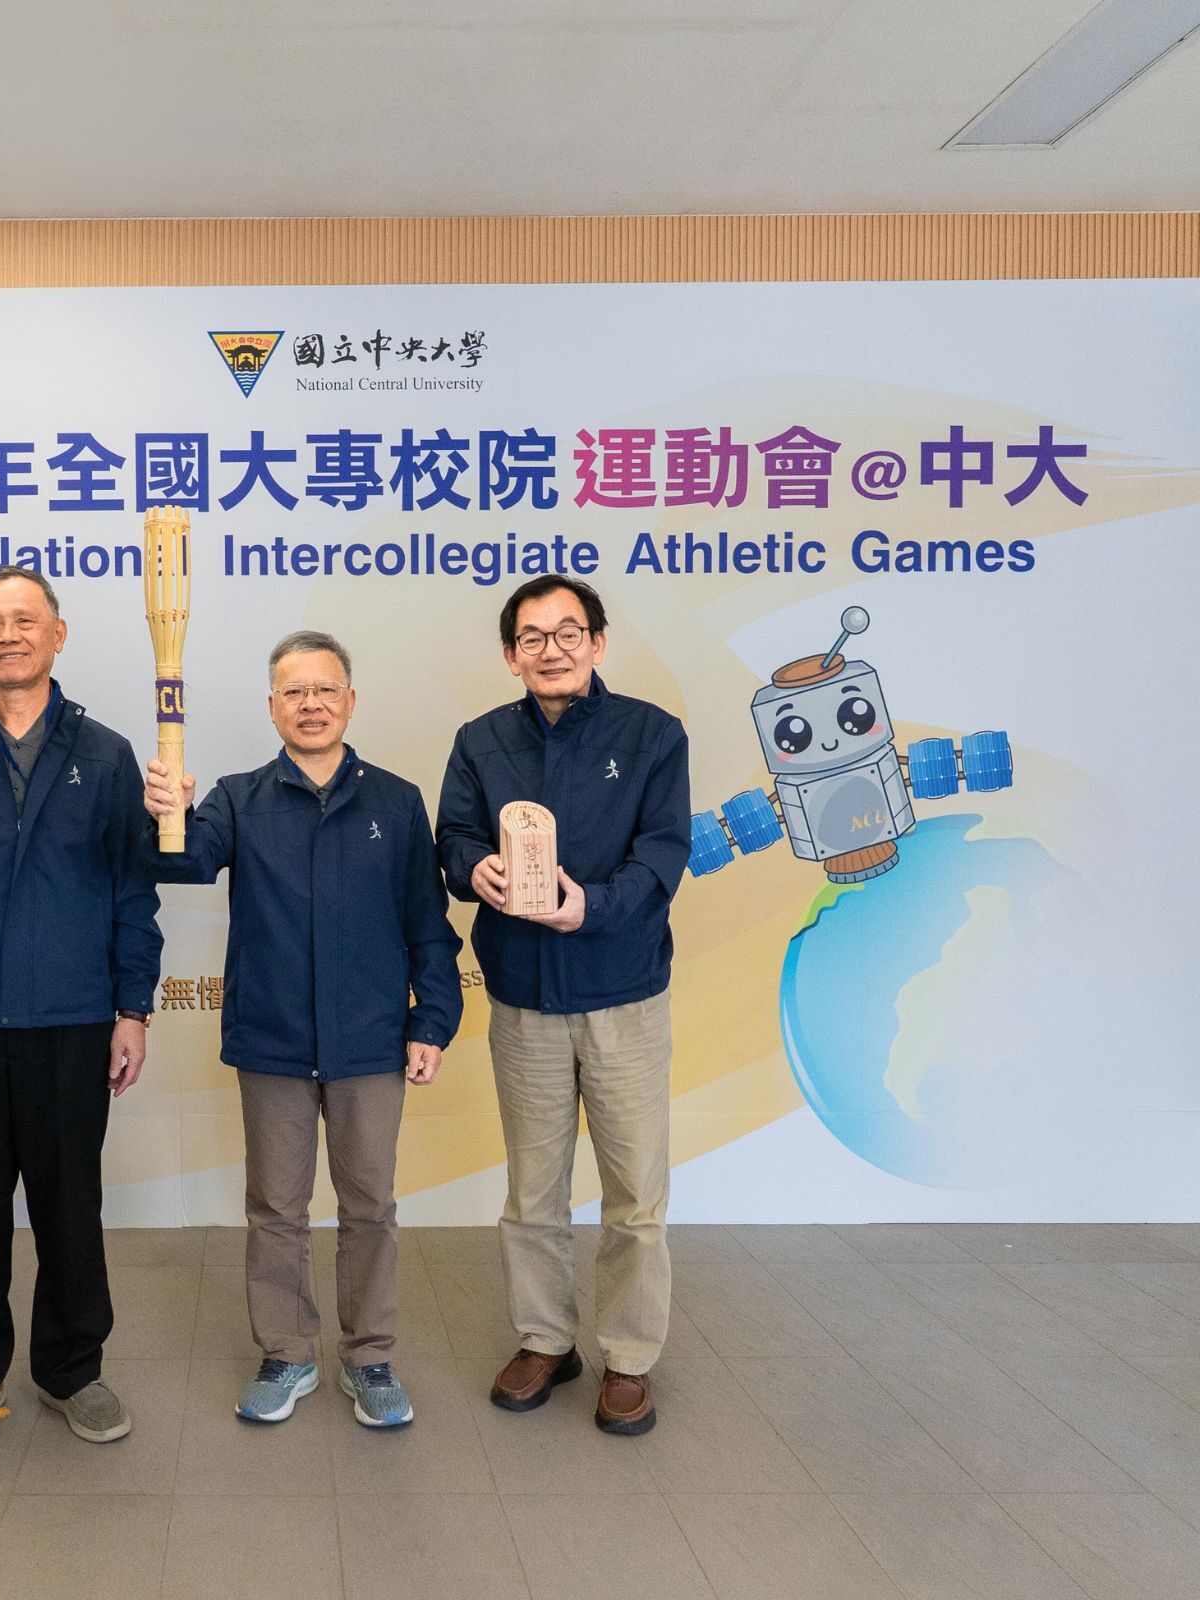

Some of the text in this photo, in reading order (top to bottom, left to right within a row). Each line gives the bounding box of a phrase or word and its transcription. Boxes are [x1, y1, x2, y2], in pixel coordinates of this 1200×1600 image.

[293, 329, 488, 370] 國立中央大學
[296, 377, 484, 392] National Central University
[224, 532, 599, 586] Intercollegiate
[625, 531, 826, 575] Athletic
[851, 530, 1036, 573] Games
